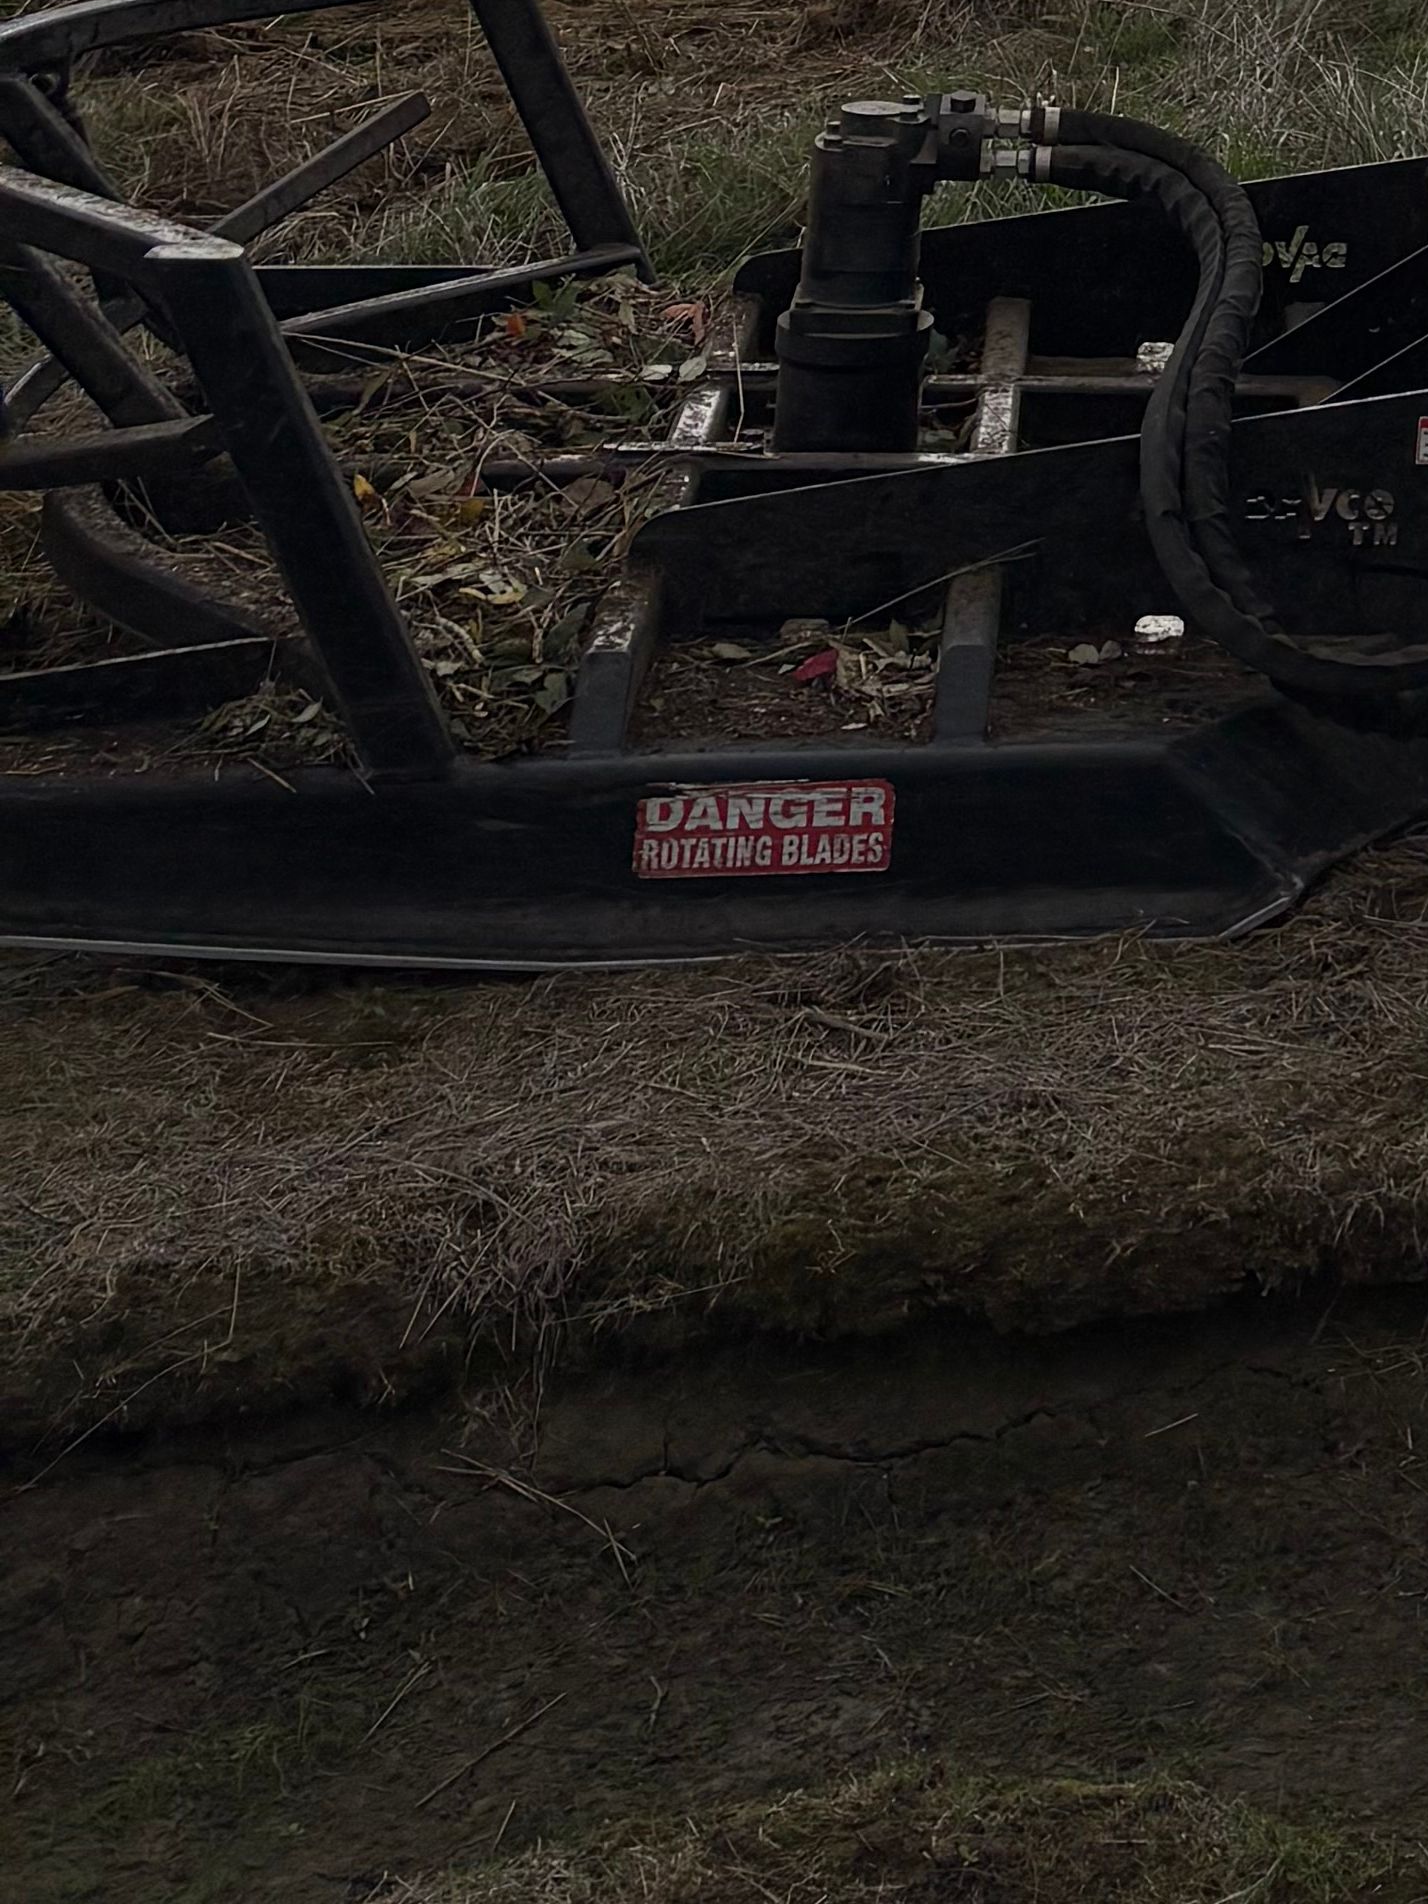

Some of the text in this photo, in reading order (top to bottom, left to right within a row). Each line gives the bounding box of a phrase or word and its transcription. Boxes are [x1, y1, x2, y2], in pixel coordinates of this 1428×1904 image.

[1347, 523, 1398, 547] TM
[645, 786, 887, 832] DANGER
[641, 832, 885, 871] ROTATING BLADES
